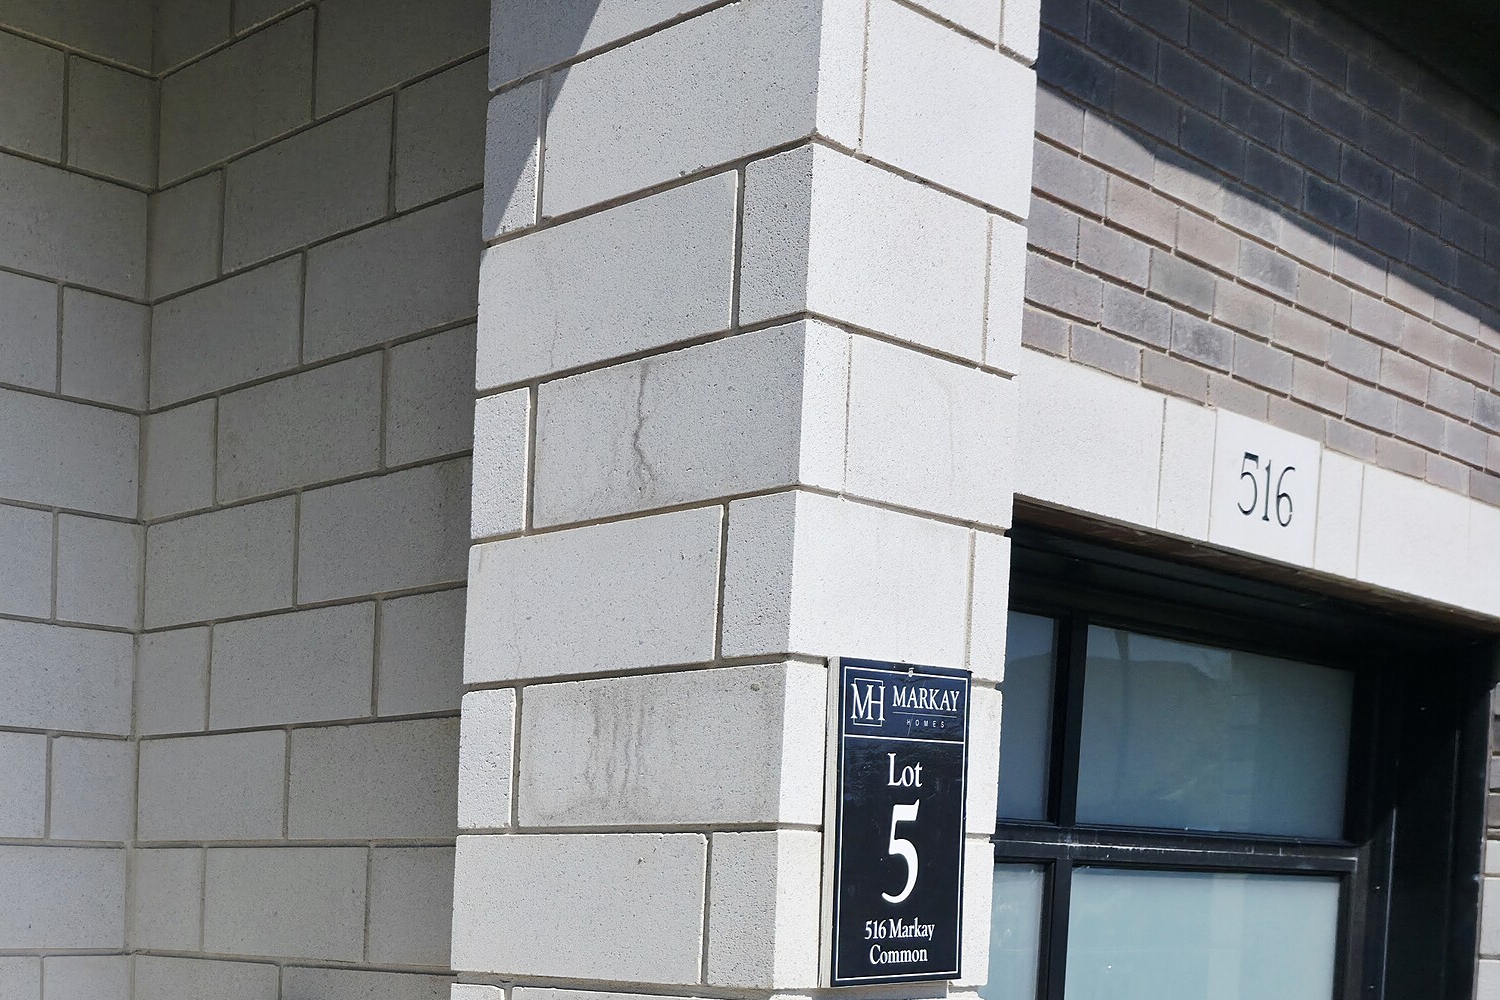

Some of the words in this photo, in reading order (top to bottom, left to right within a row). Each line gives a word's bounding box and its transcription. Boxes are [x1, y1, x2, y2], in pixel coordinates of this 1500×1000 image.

[1237, 451, 1296, 528] 516
[850, 683, 886, 721] MH
[892, 685, 960, 712] MARKAY
[906, 719, 946, 729] HOMES
[887, 752, 923, 788] Lot
[881, 798, 920, 904] 5
[864, 919, 887, 940] 516
[888, 916, 936, 941] Markay
[869, 943, 928, 965] Common
